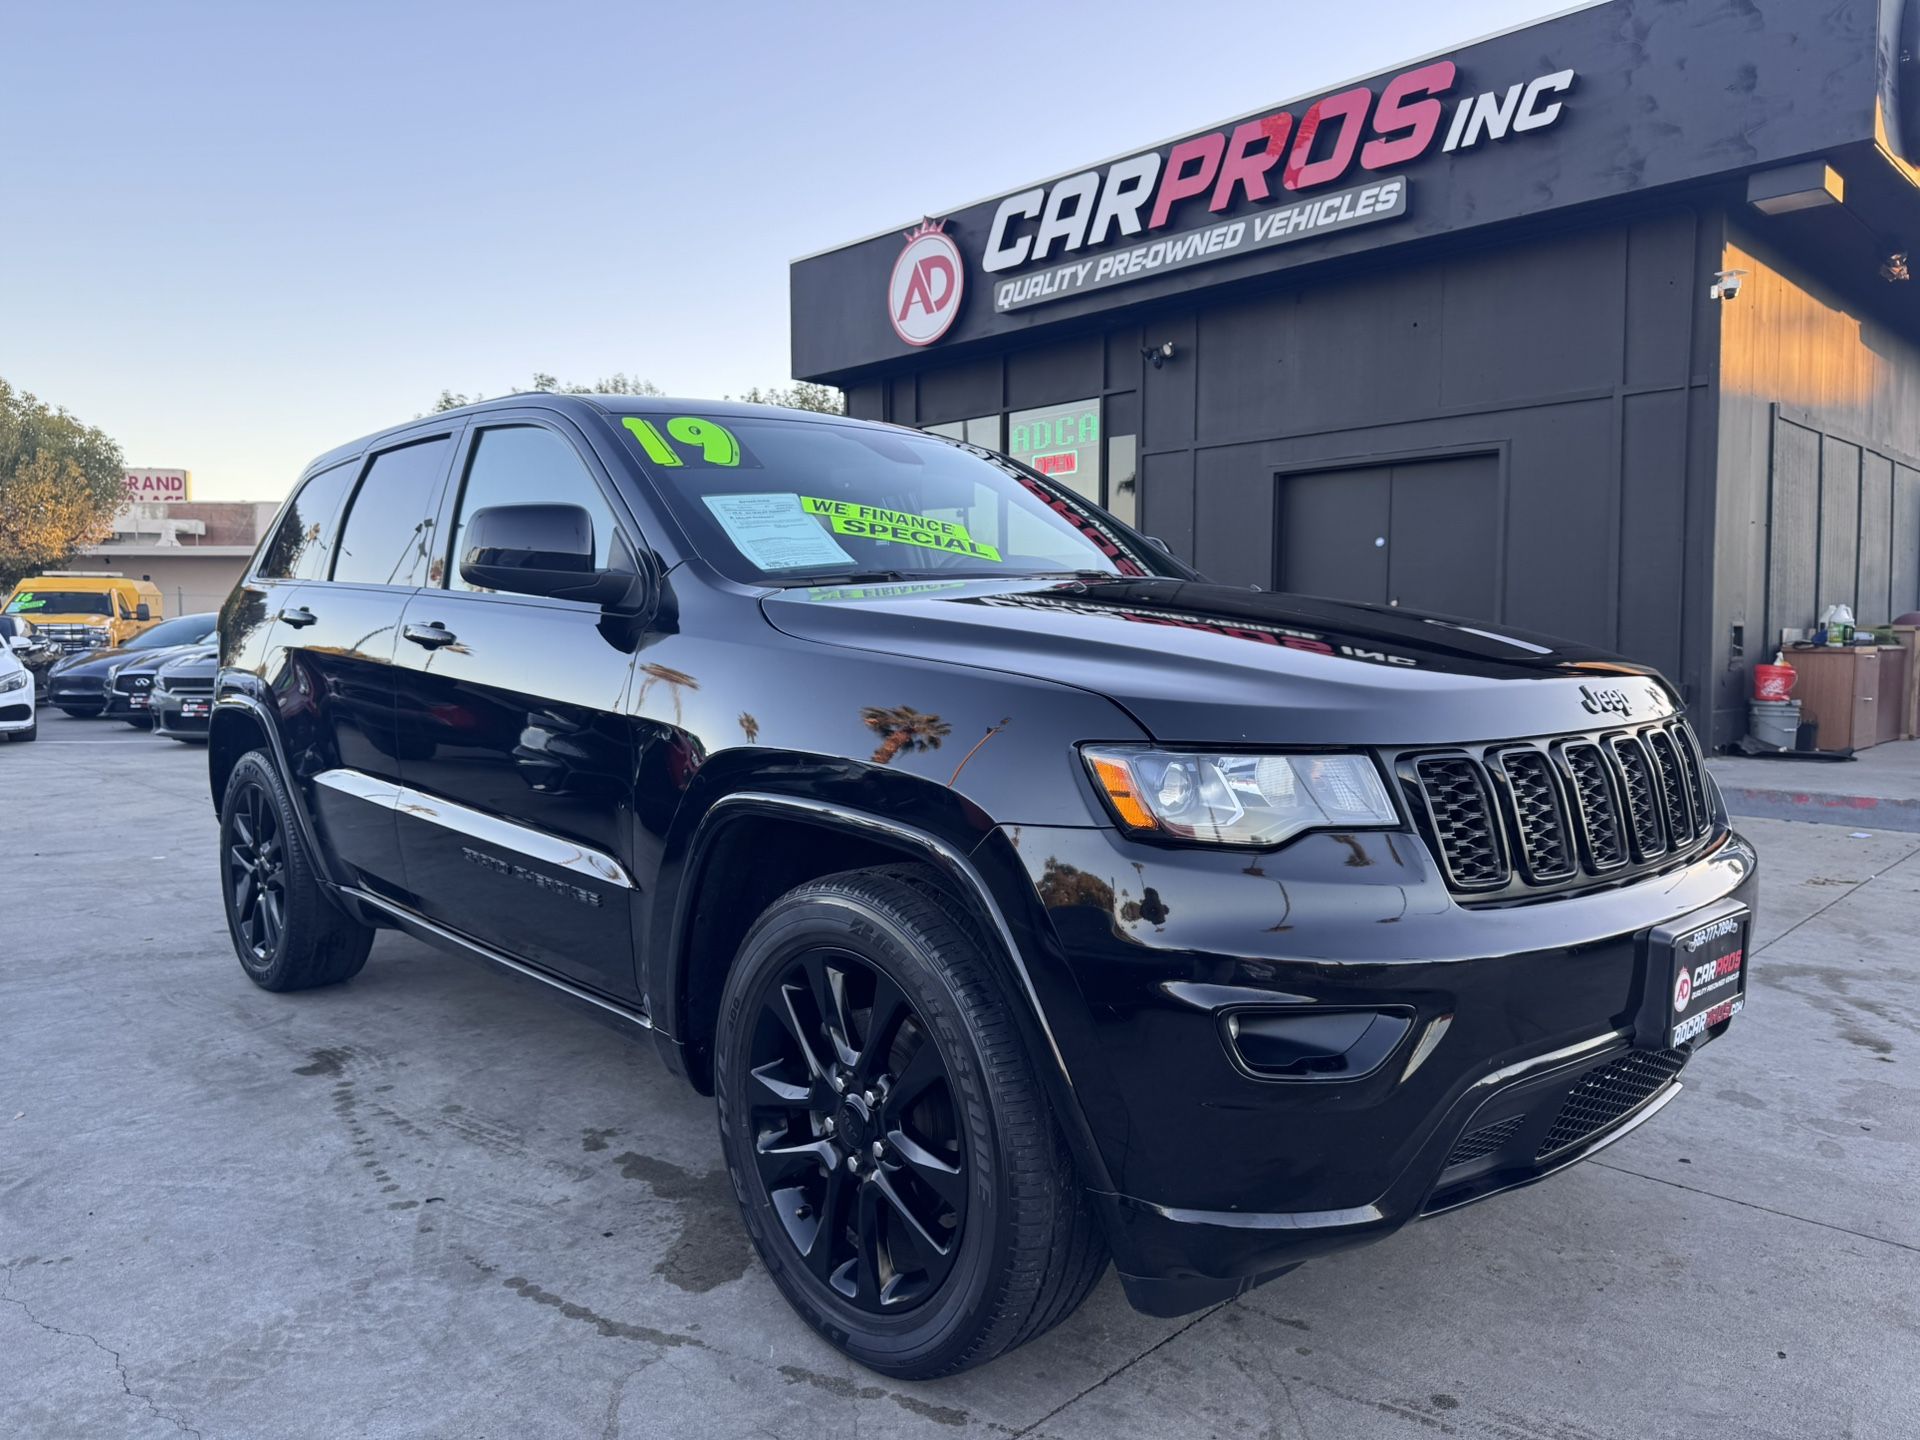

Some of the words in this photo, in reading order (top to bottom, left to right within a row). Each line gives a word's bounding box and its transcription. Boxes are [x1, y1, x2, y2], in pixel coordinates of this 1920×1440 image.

[1442, 69, 1574, 152] INC
[998, 262, 1093, 308] QUALITY
[1254, 182, 1401, 242] VEHICLES
[898, 255, 955, 321] AD
[621, 417, 741, 467] 19
[1013, 413, 1098, 453] ADCA
[1034, 453, 1076, 475] OPEN
[812, 499, 848, 516] WE
[859, 506, 954, 535] FINANCE
[843, 519, 990, 557] SPECIAL
[1578, 684, 1633, 717] Jeep
